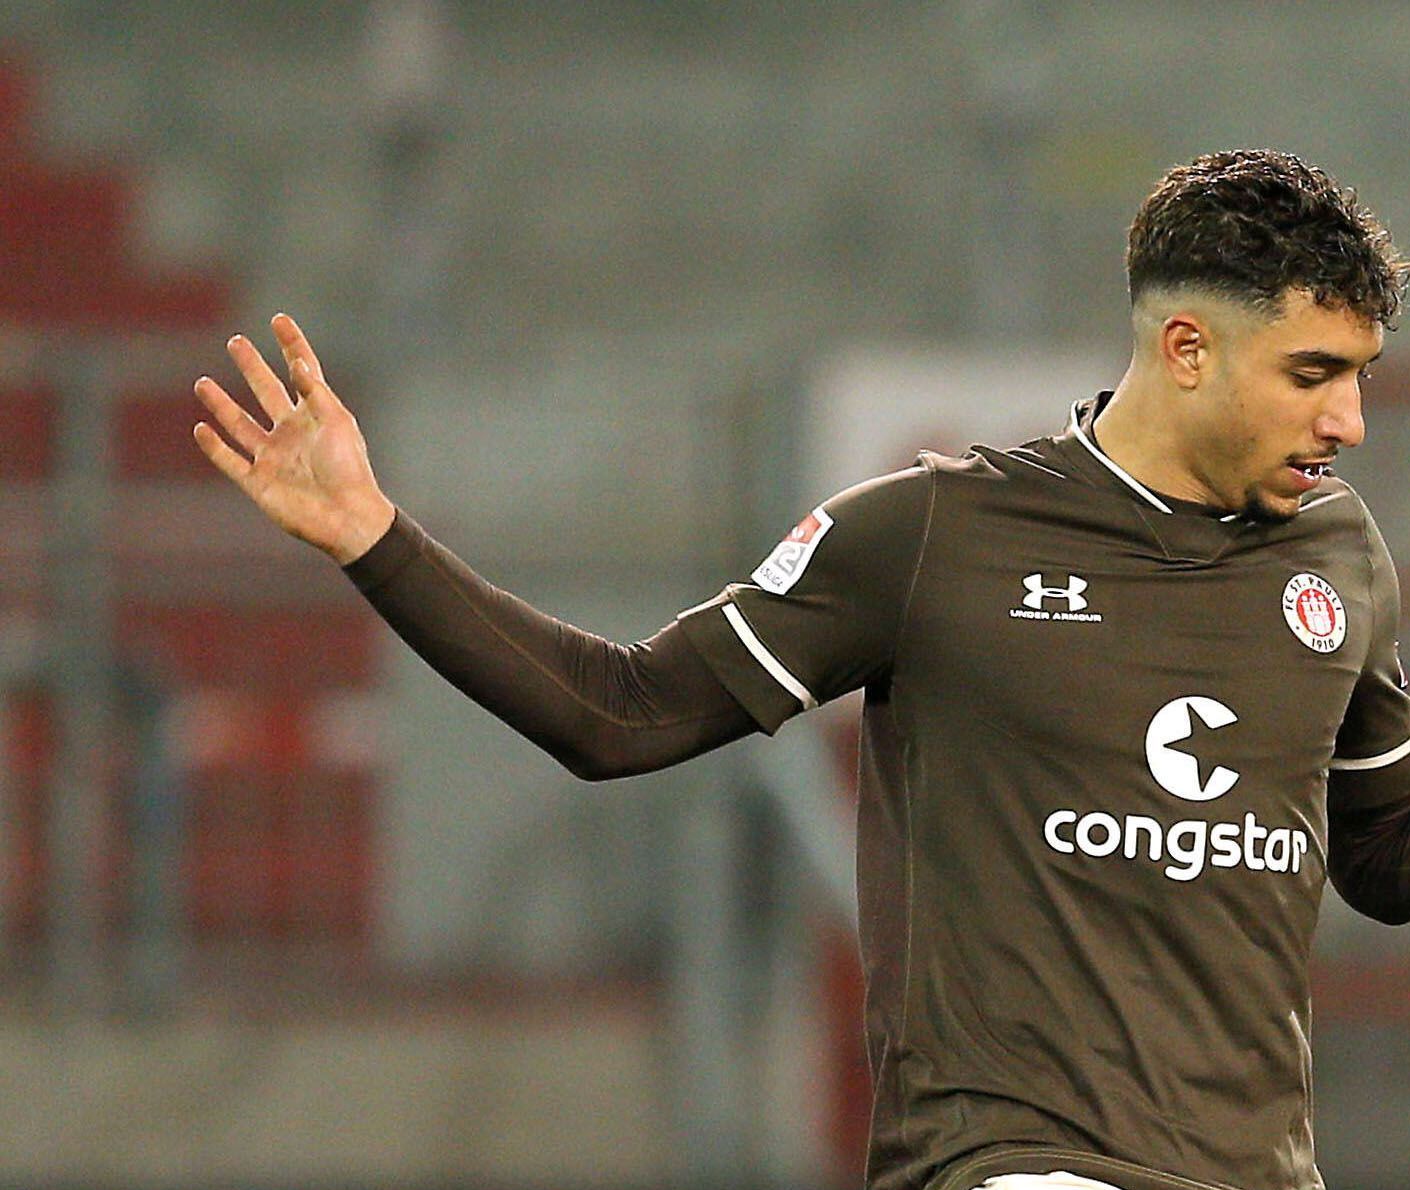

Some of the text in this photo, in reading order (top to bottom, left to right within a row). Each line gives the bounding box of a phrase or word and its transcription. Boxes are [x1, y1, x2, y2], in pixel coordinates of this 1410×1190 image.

[1009, 609, 1102, 622] UNDER ARMOUR
[1310, 637, 1336, 651] 1910
[1044, 809, 1308, 882] congstar
